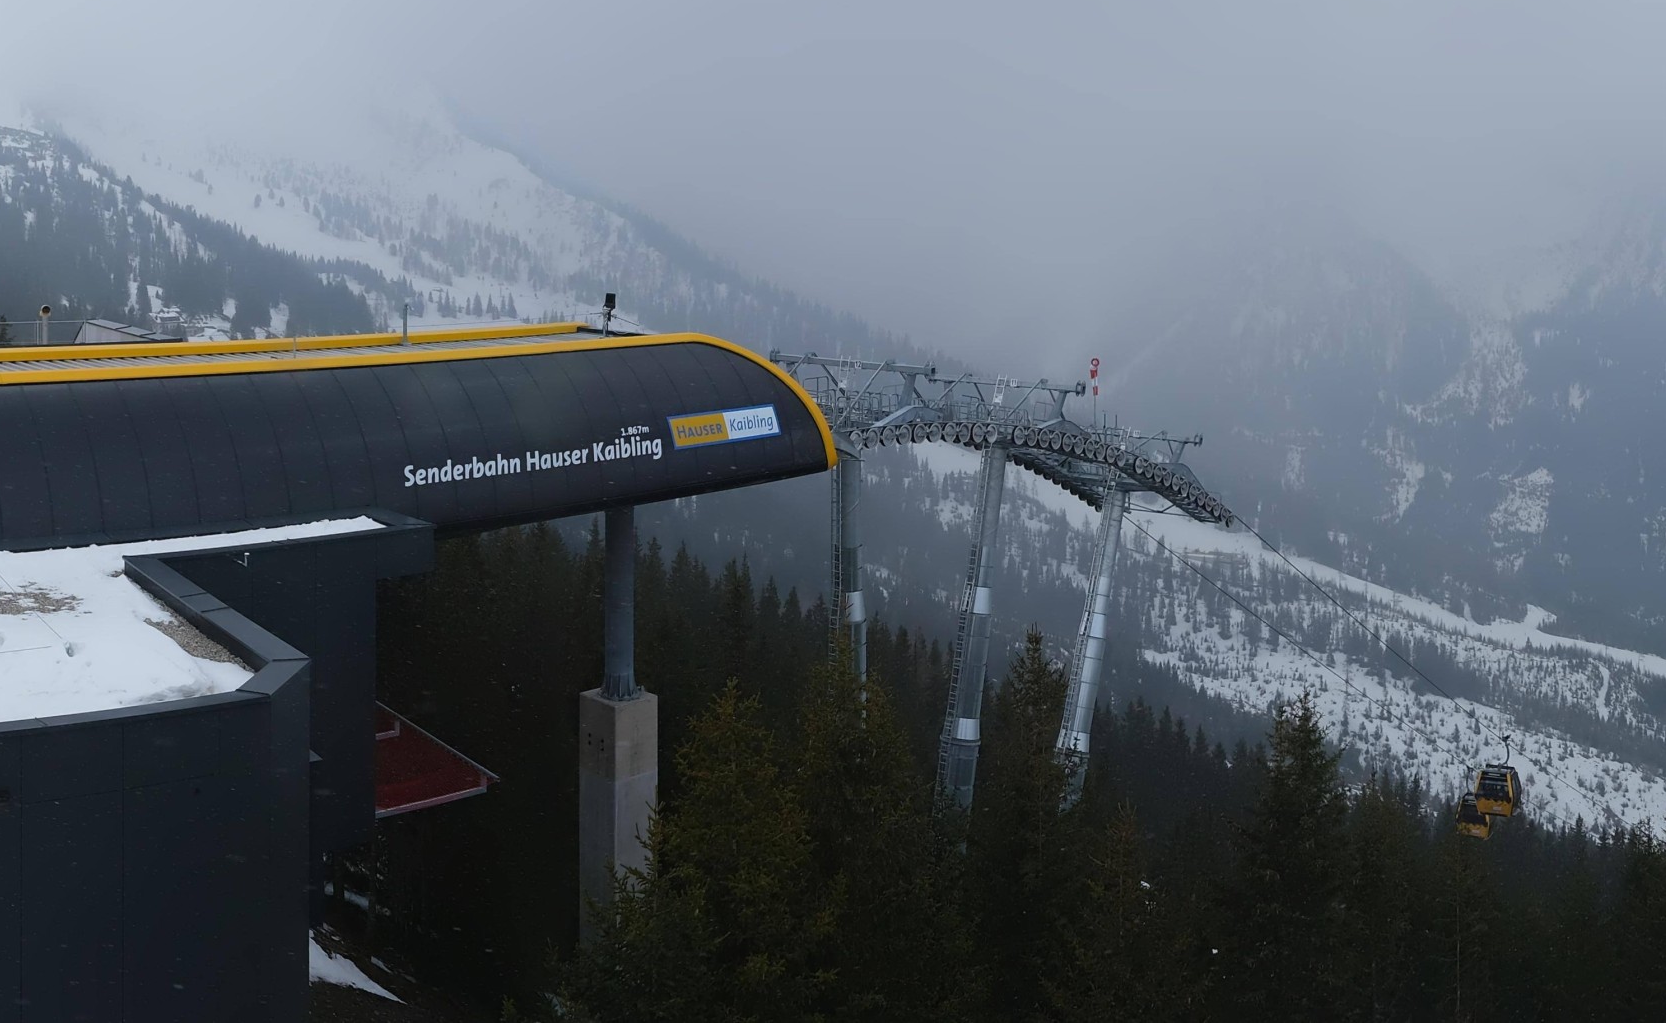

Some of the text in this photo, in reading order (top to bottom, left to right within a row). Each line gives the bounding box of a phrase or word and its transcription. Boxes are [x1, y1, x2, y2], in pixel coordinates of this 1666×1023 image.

[620, 425, 650, 436] 1.867m
[676, 414, 774, 438] HAUSER Kaibling
[403, 436, 662, 487] Senderbahn Hauser Kaibling
